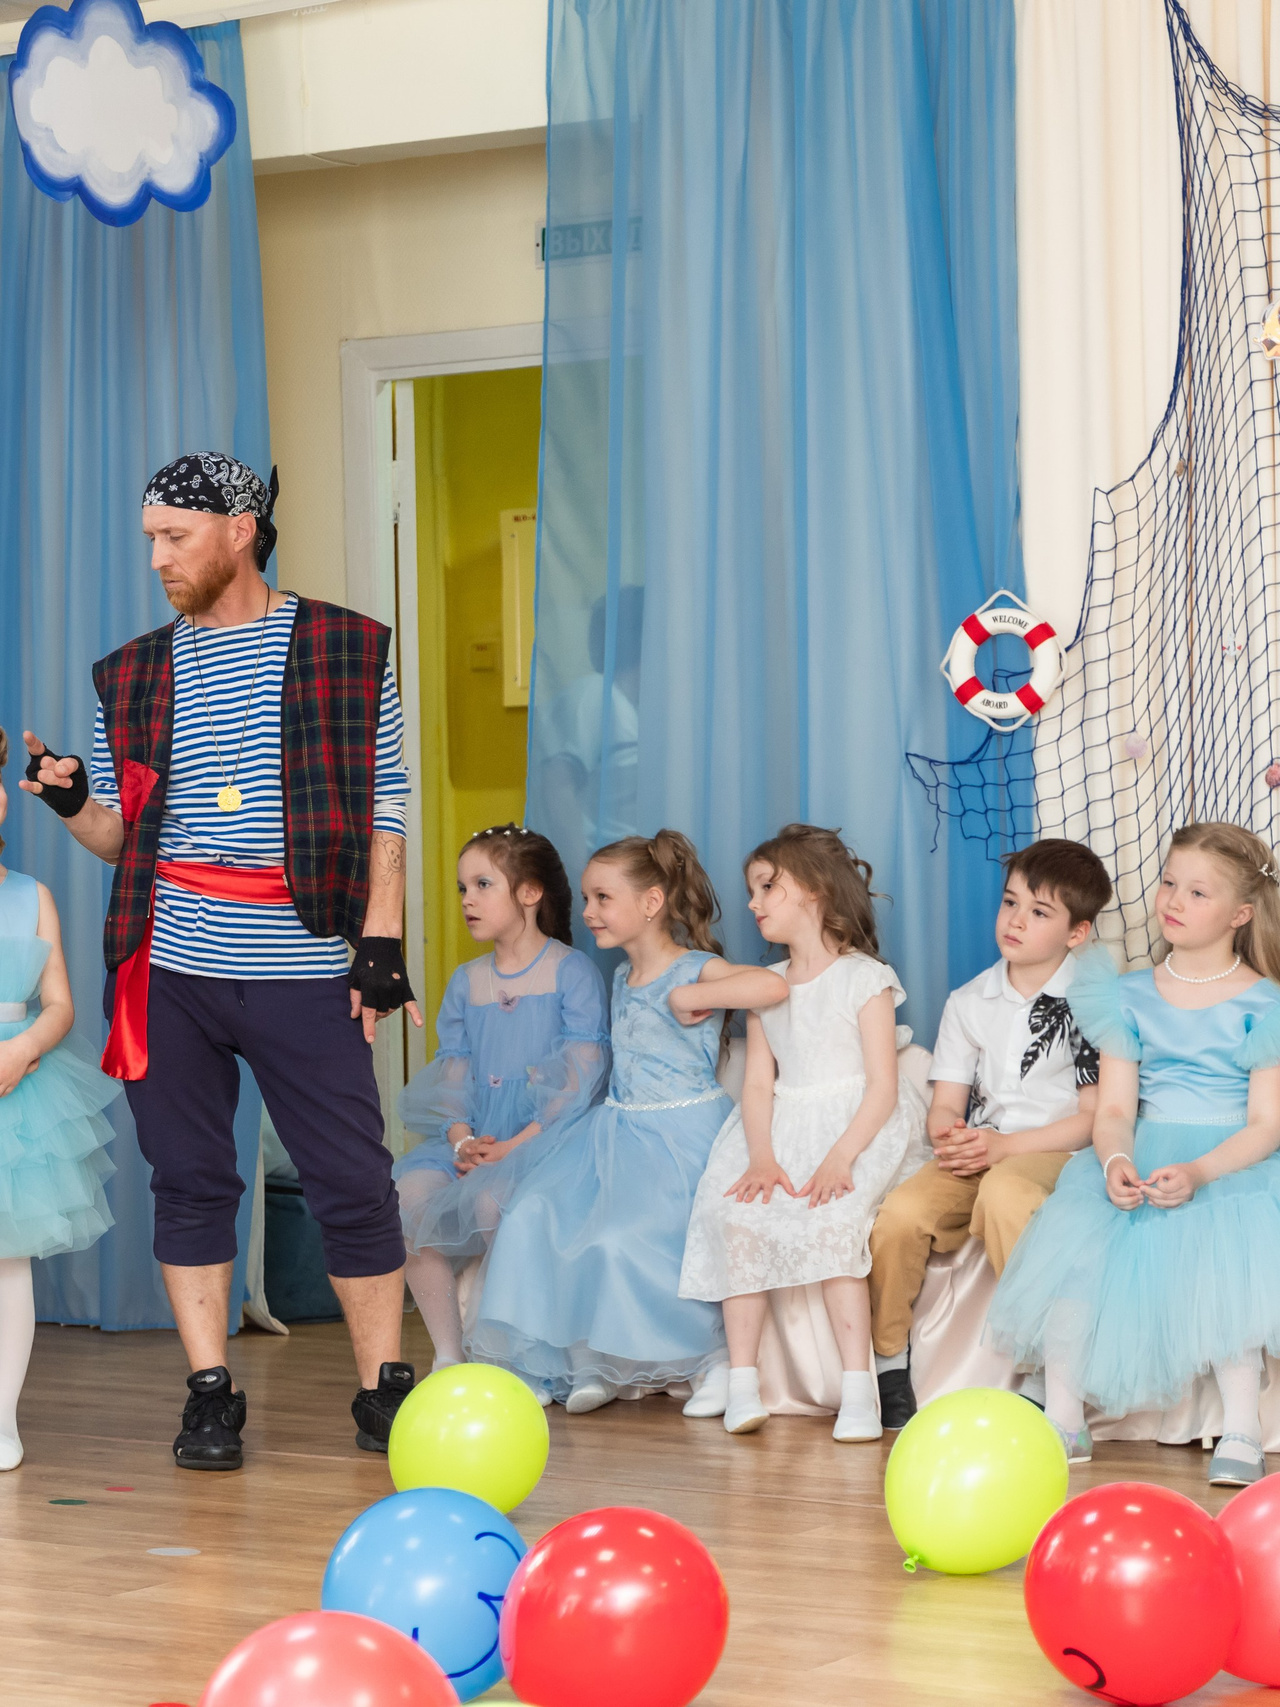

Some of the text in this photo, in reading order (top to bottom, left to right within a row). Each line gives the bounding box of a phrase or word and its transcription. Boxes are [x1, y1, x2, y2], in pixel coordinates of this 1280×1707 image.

[551, 224, 639, 256] ВЫХ
[991, 614, 1029, 629] WELCOME
[981, 698, 1009, 709] ABOARD
